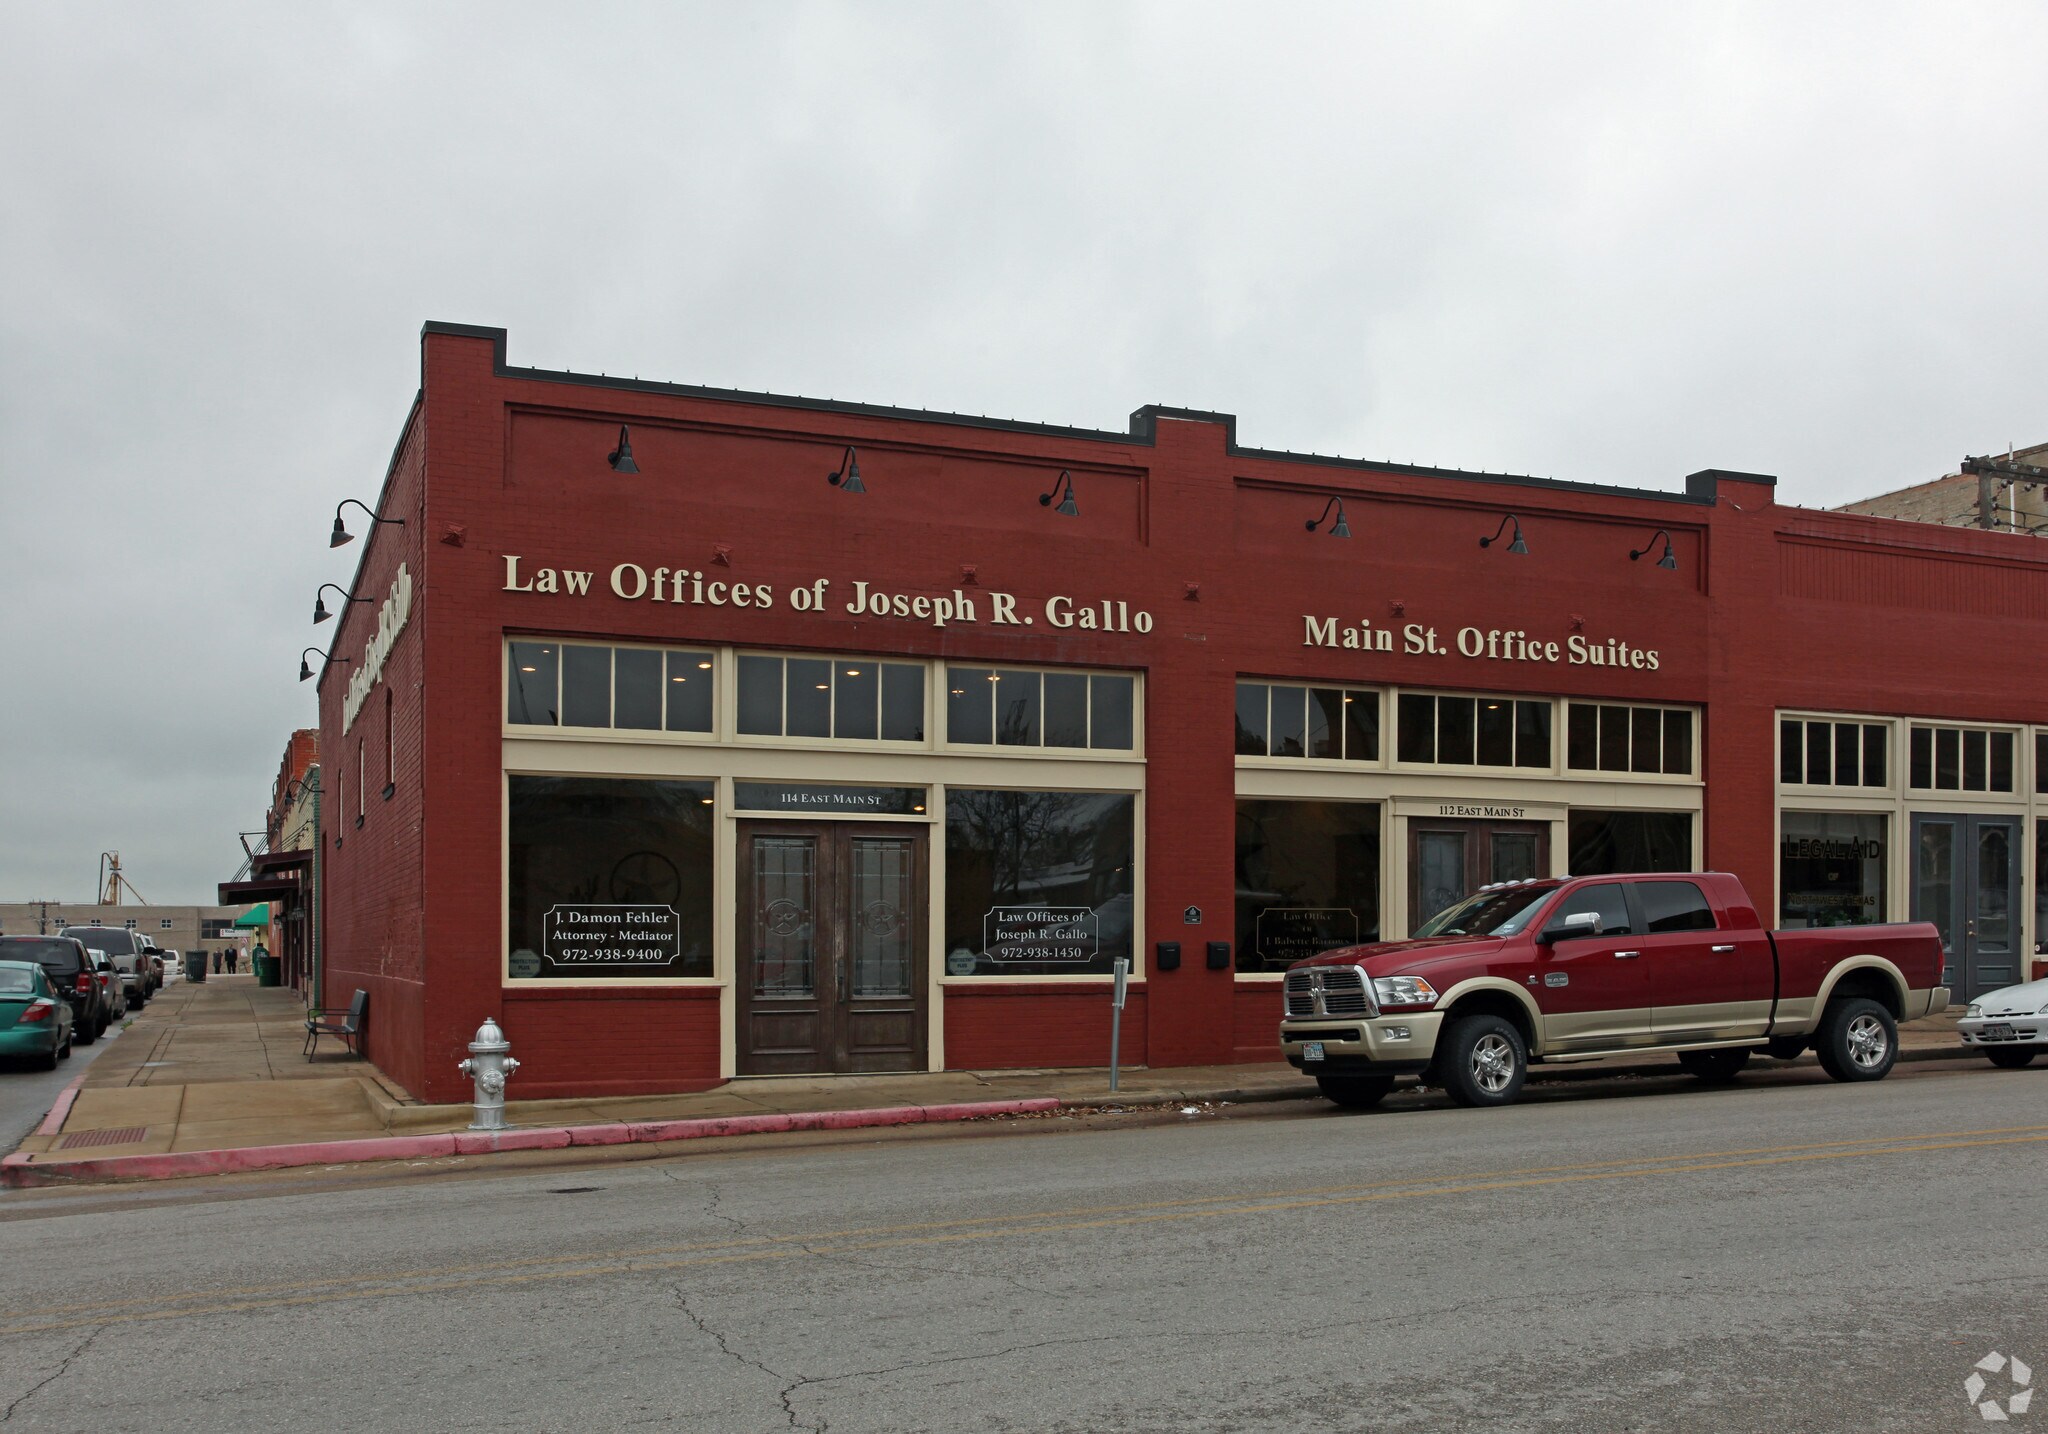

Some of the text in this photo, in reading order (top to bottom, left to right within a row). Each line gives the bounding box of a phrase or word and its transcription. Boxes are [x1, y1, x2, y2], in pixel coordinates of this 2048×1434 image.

[502, 555, 1153, 633] Law Offices of Joseph R. Gallo
[1302, 615, 1660, 670] Main St. Office Suites
[781, 793, 881, 805] 114 EAST MAIN ST
[1439, 805, 1525, 818] 112 EAST MAIN ST
[1786, 834, 1880, 859] LEGAL AID
[555, 912, 669, 925] J. Damon Fehler
[998, 911, 1085, 922] Law Offices of
[552, 930, 607, 943] Attorney
[618, 930, 674, 941] Mediator
[996, 928, 1088, 942] Joseph R. Gallo
[562, 948, 663, 961] 972-938-9400
[1001, 947, 1082, 958] 972-938-1450
